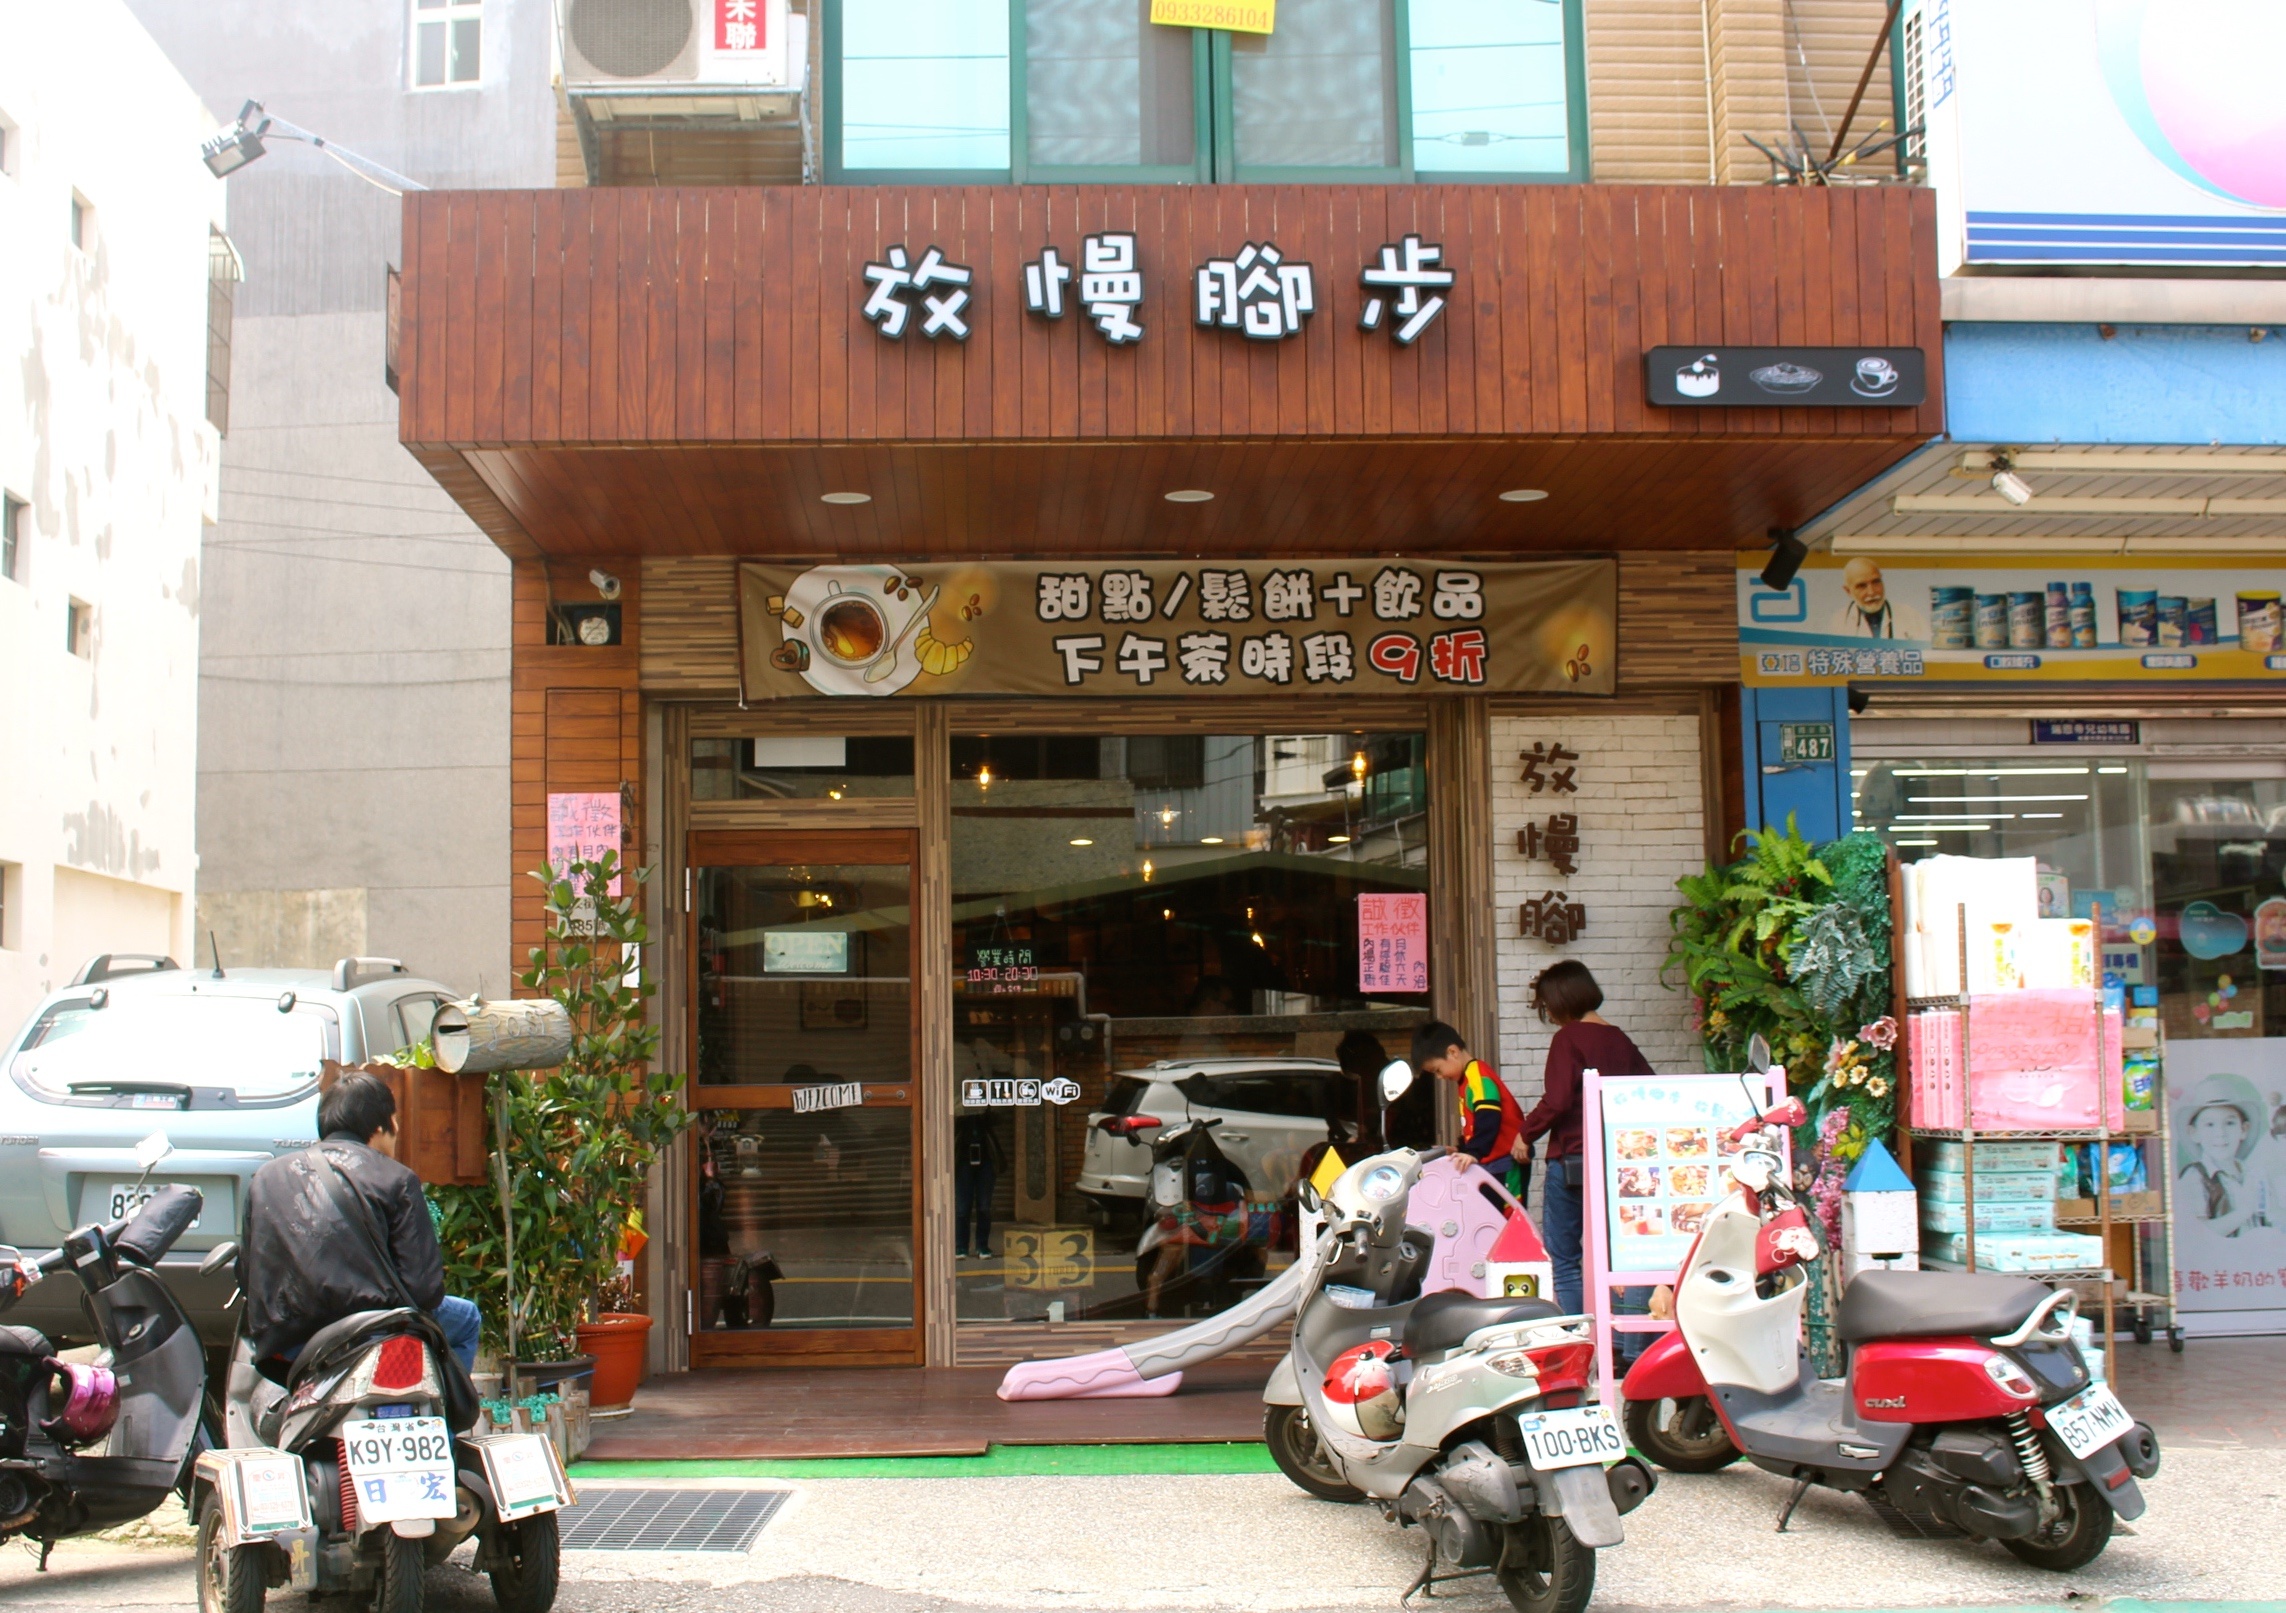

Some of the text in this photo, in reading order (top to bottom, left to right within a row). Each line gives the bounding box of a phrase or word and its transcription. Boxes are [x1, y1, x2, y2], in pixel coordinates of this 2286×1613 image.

[1155, 2, 1268, 28] 0933286104
[863, 231, 1456, 348] 放慢腳步
[1053, 627, 1487, 684] 下午茶時段9折
[1807, 649, 1924, 676] 特殊營養品
[1798, 737, 1829, 757] 487
[1517, 742, 1586, 1009] 放慢腳
[765, 934, 843, 956] OPEN
[966, 966, 1039, 982] 10:30-20:30
[377, 1421, 415, 1434] 台灣省
